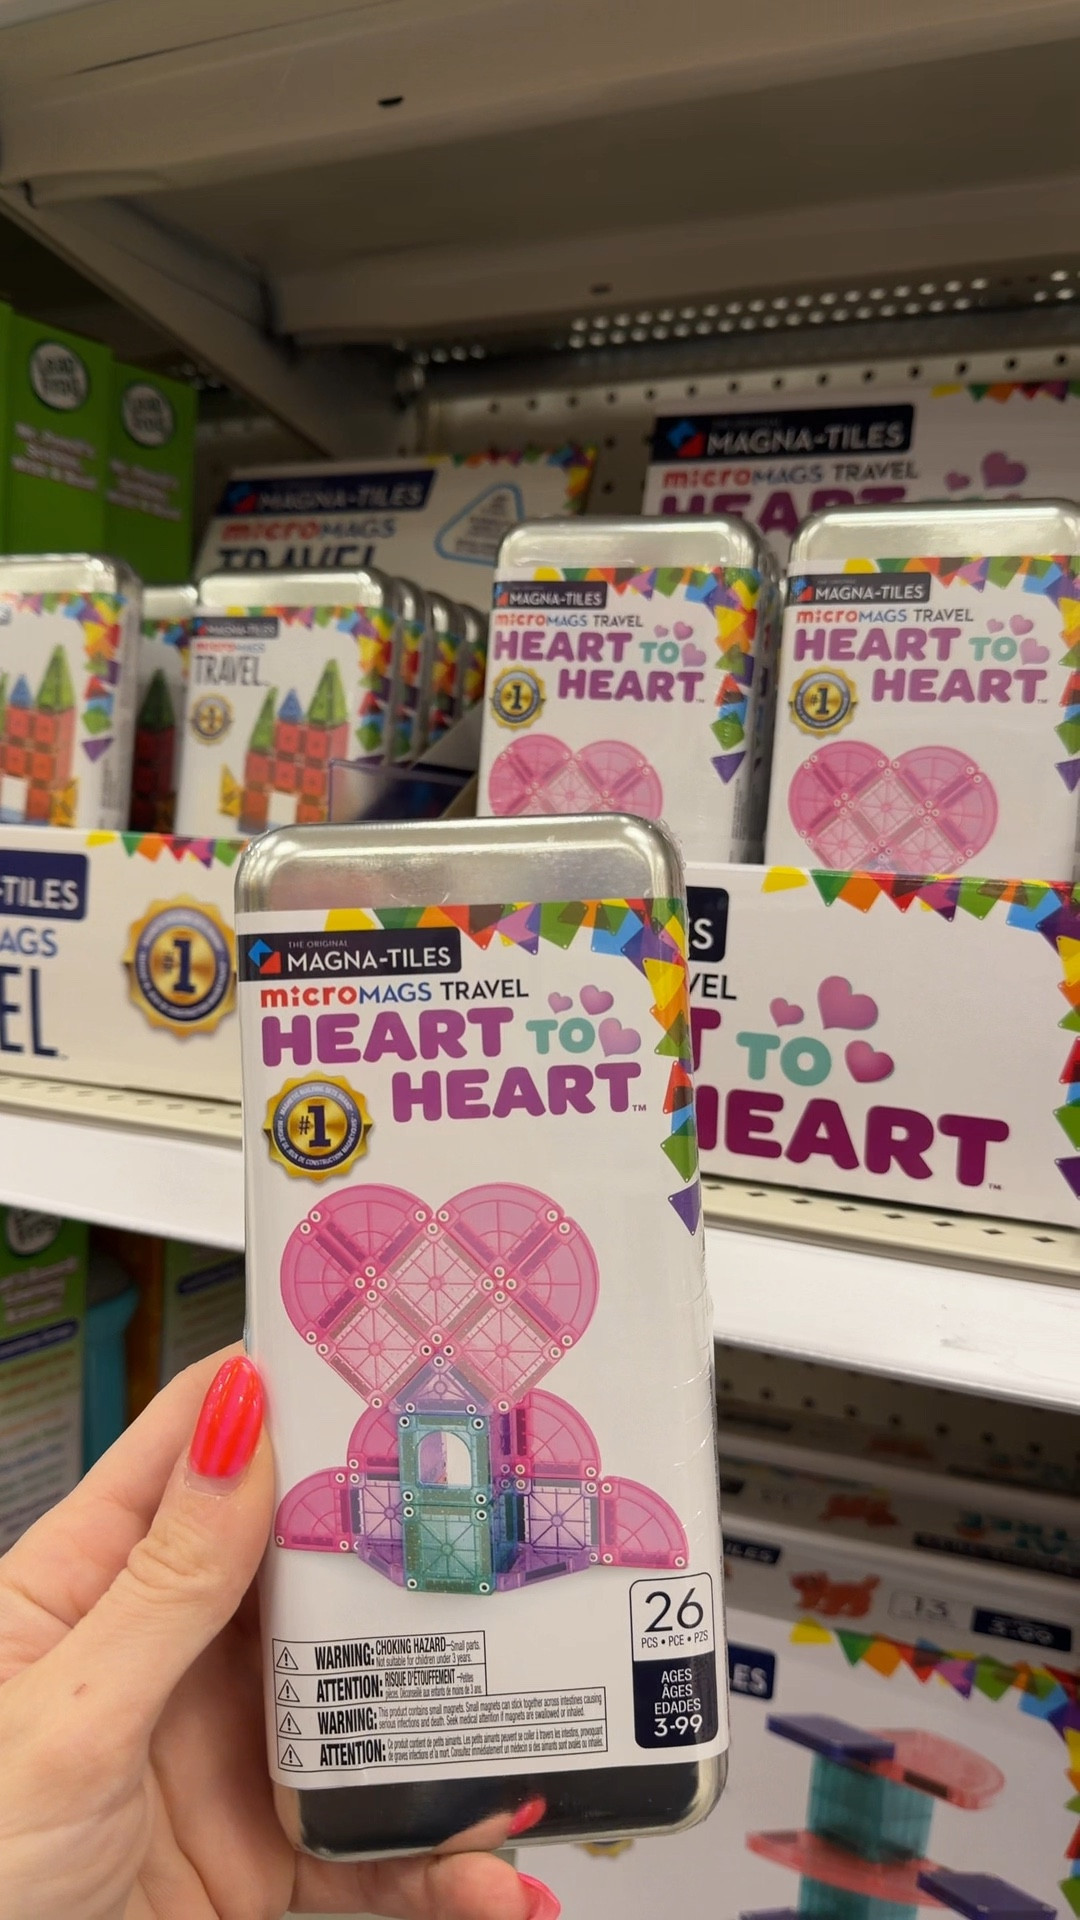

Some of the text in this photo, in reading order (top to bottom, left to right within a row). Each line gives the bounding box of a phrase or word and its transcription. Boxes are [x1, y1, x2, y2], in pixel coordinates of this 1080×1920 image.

[706, 420, 905, 456] MAGNA-TILES
[832, 460, 920, 482] TRAVEL
[509, 591, 602, 607] MAGNA-TILES
[814, 584, 924, 601] MAGNA-TILES
[593, 614, 643, 628] TRAVEL
[914, 608, 974, 623] TRAVEL
[494, 630, 680, 664] HEART TO
[793, 627, 1018, 662] HEART TO
[558, 669, 705, 703] HEART
[871, 668, 1048, 704] HEART
[288, 939, 348, 949] THE ORIGINAL
[287, 948, 451, 973] MAGNA-TILES
[260, 979, 529, 1008] microMAGS TRAVEL
[261, 1007, 596, 1067] HEART TO
[736, 1031, 832, 1087] TO
[392, 1062, 642, 1123] HEART
[299, 1105, 331, 1148] #1
[644, 1587, 704, 1633] 26
[376, 1639, 411, 1655] CHOKING
[641, 1630, 708, 1649] PCS PCE PZS
[315, 1642, 374, 1670] WARNING:
[376, 1657, 385, 1667] Not
[316, 1674, 383, 1703] ATTENTION:
[385, 1671, 406, 1688] RISQUE
[661, 1668, 692, 1684] AGES
[661, 1683, 693, 1699] ÂGES
[654, 1698, 701, 1715] EDADES
[317, 1707, 378, 1735] WARNING:
[654, 1714, 703, 1737] 3-99
[320, 1739, 386, 1767] ATTENTION:
